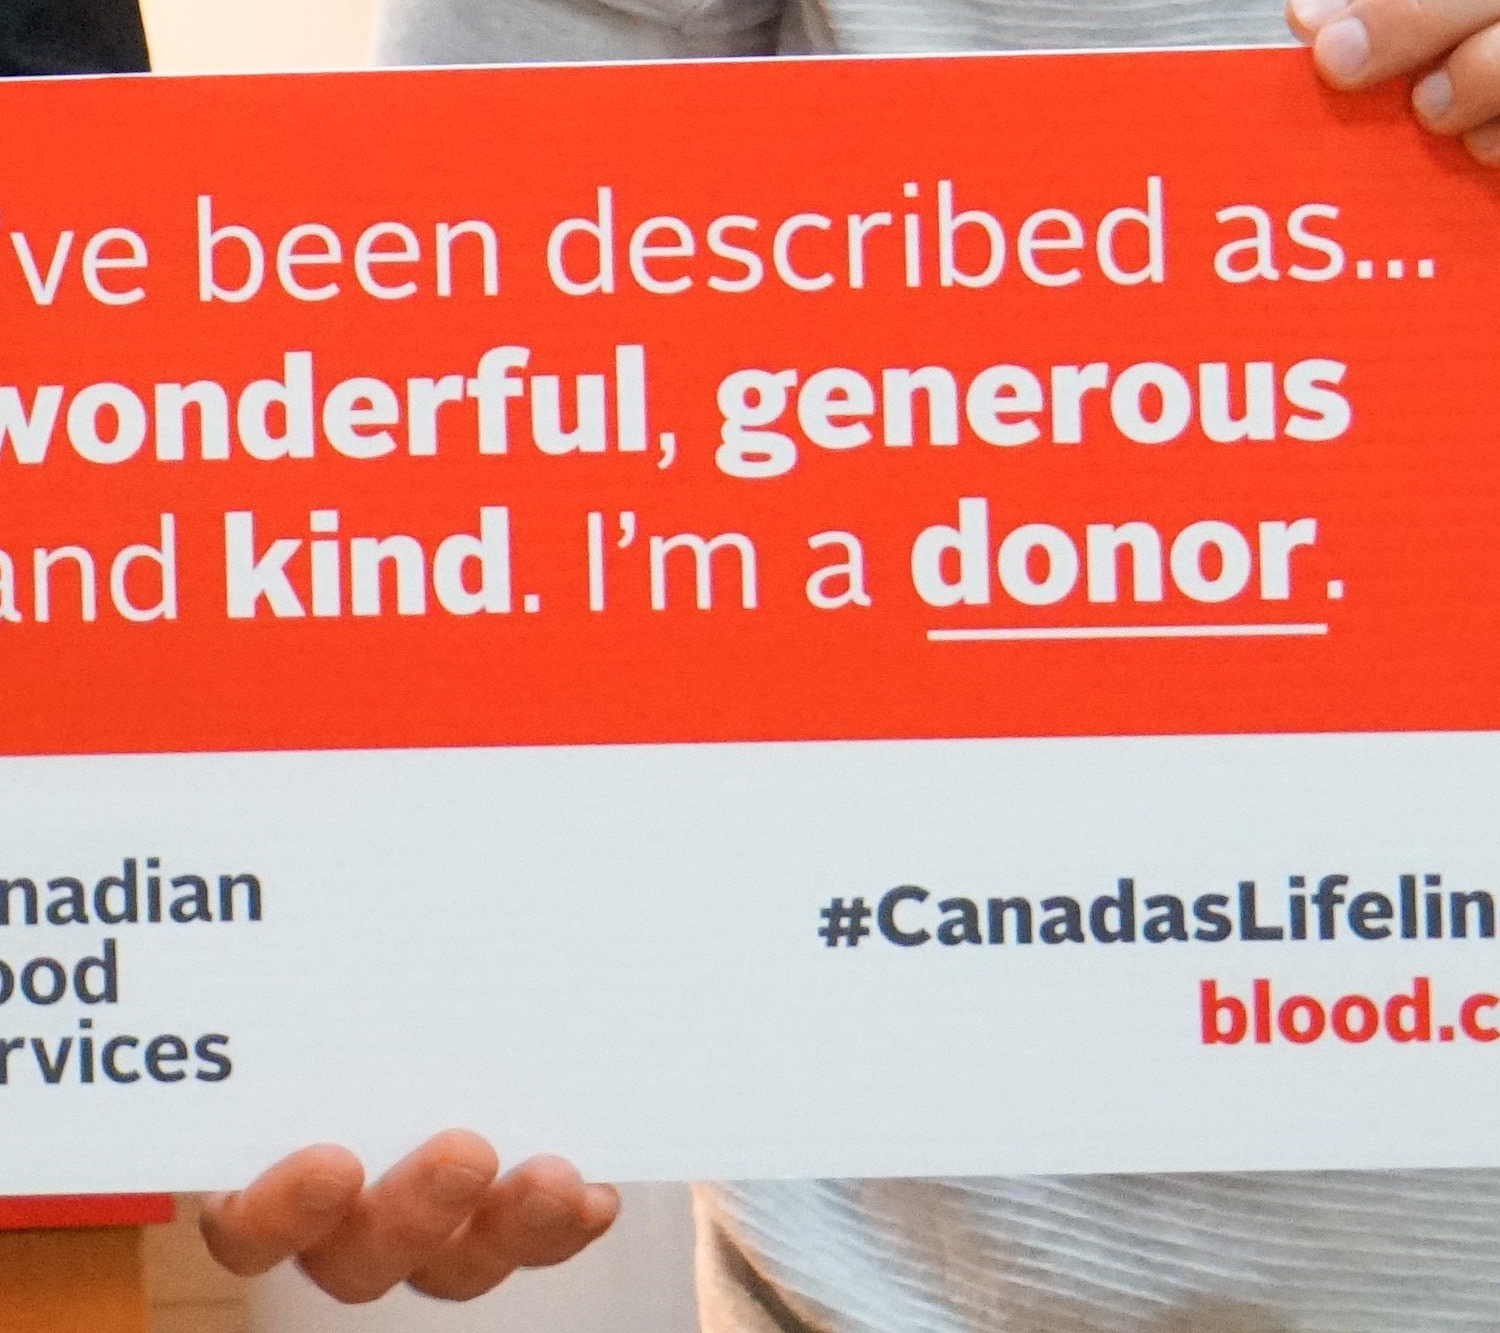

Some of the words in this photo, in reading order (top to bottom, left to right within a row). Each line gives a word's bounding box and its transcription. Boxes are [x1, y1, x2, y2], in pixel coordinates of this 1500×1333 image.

[198, 193, 499, 303] been
[548, 175, 1166, 296] described
[1214, 203, 1435, 283] as...
[715, 359, 1353, 479] generous
[225, 506, 541, 619] kind.
[588, 510, 758, 612] I’m
[806, 530, 872, 609] a
[911, 497, 1344, 607] donor.
